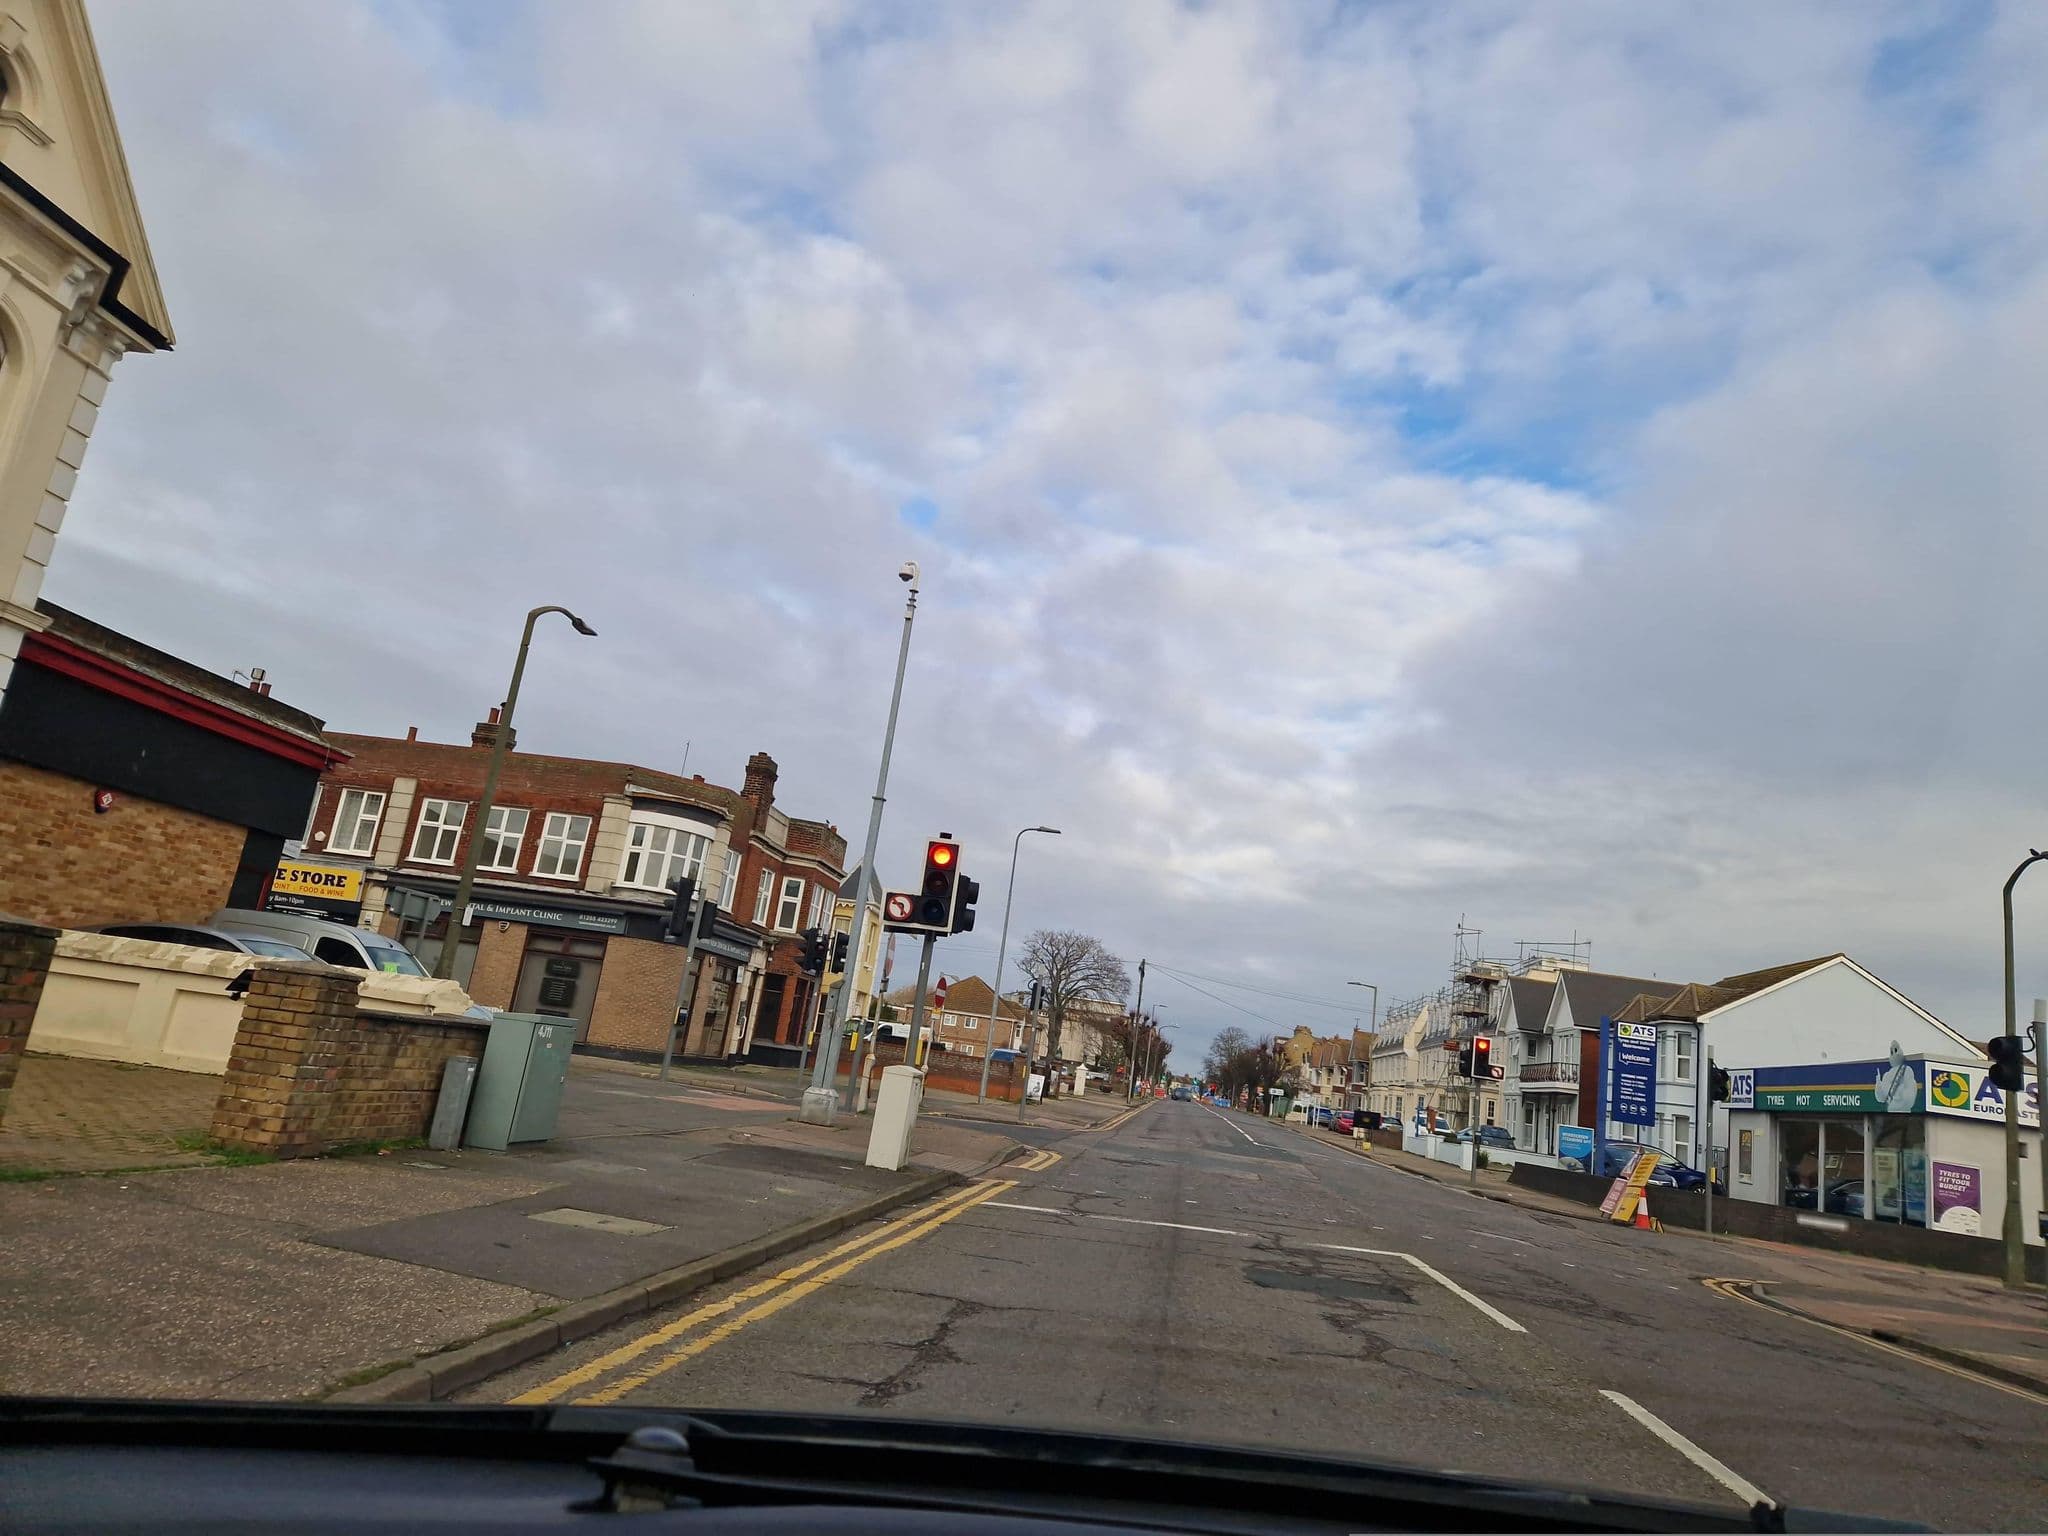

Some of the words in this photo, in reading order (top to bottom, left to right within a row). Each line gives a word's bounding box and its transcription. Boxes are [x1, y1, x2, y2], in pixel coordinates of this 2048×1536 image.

[290, 870, 347, 888] STORE
[274, 882, 290, 890] OINT
[299, 885, 318, 894] FOOD
[319, 887, 325, 895] &
[327, 888, 344, 897] WINE
[486, 903, 494, 912] &
[495, 905, 532, 917] IMPLANT
[533, 909, 563, 921] CLINIC
[1632, 1026, 1654, 1036] ATS
[1622, 1053, 1651, 1063] Welcome
[1732, 1075, 1752, 1095] ATS
[1974, 1075, 2039, 1109] AS
[1766, 1095, 1785, 1106] TYRES
[1796, 1095, 1811, 1106] MOT
[1823, 1095, 1860, 1106] SERVICING
[1939, 1169, 1960, 1179] TYRES
[1939, 1182, 1967, 1192] BUDGET
[1951, 1178, 1971, 1187] YOUR
